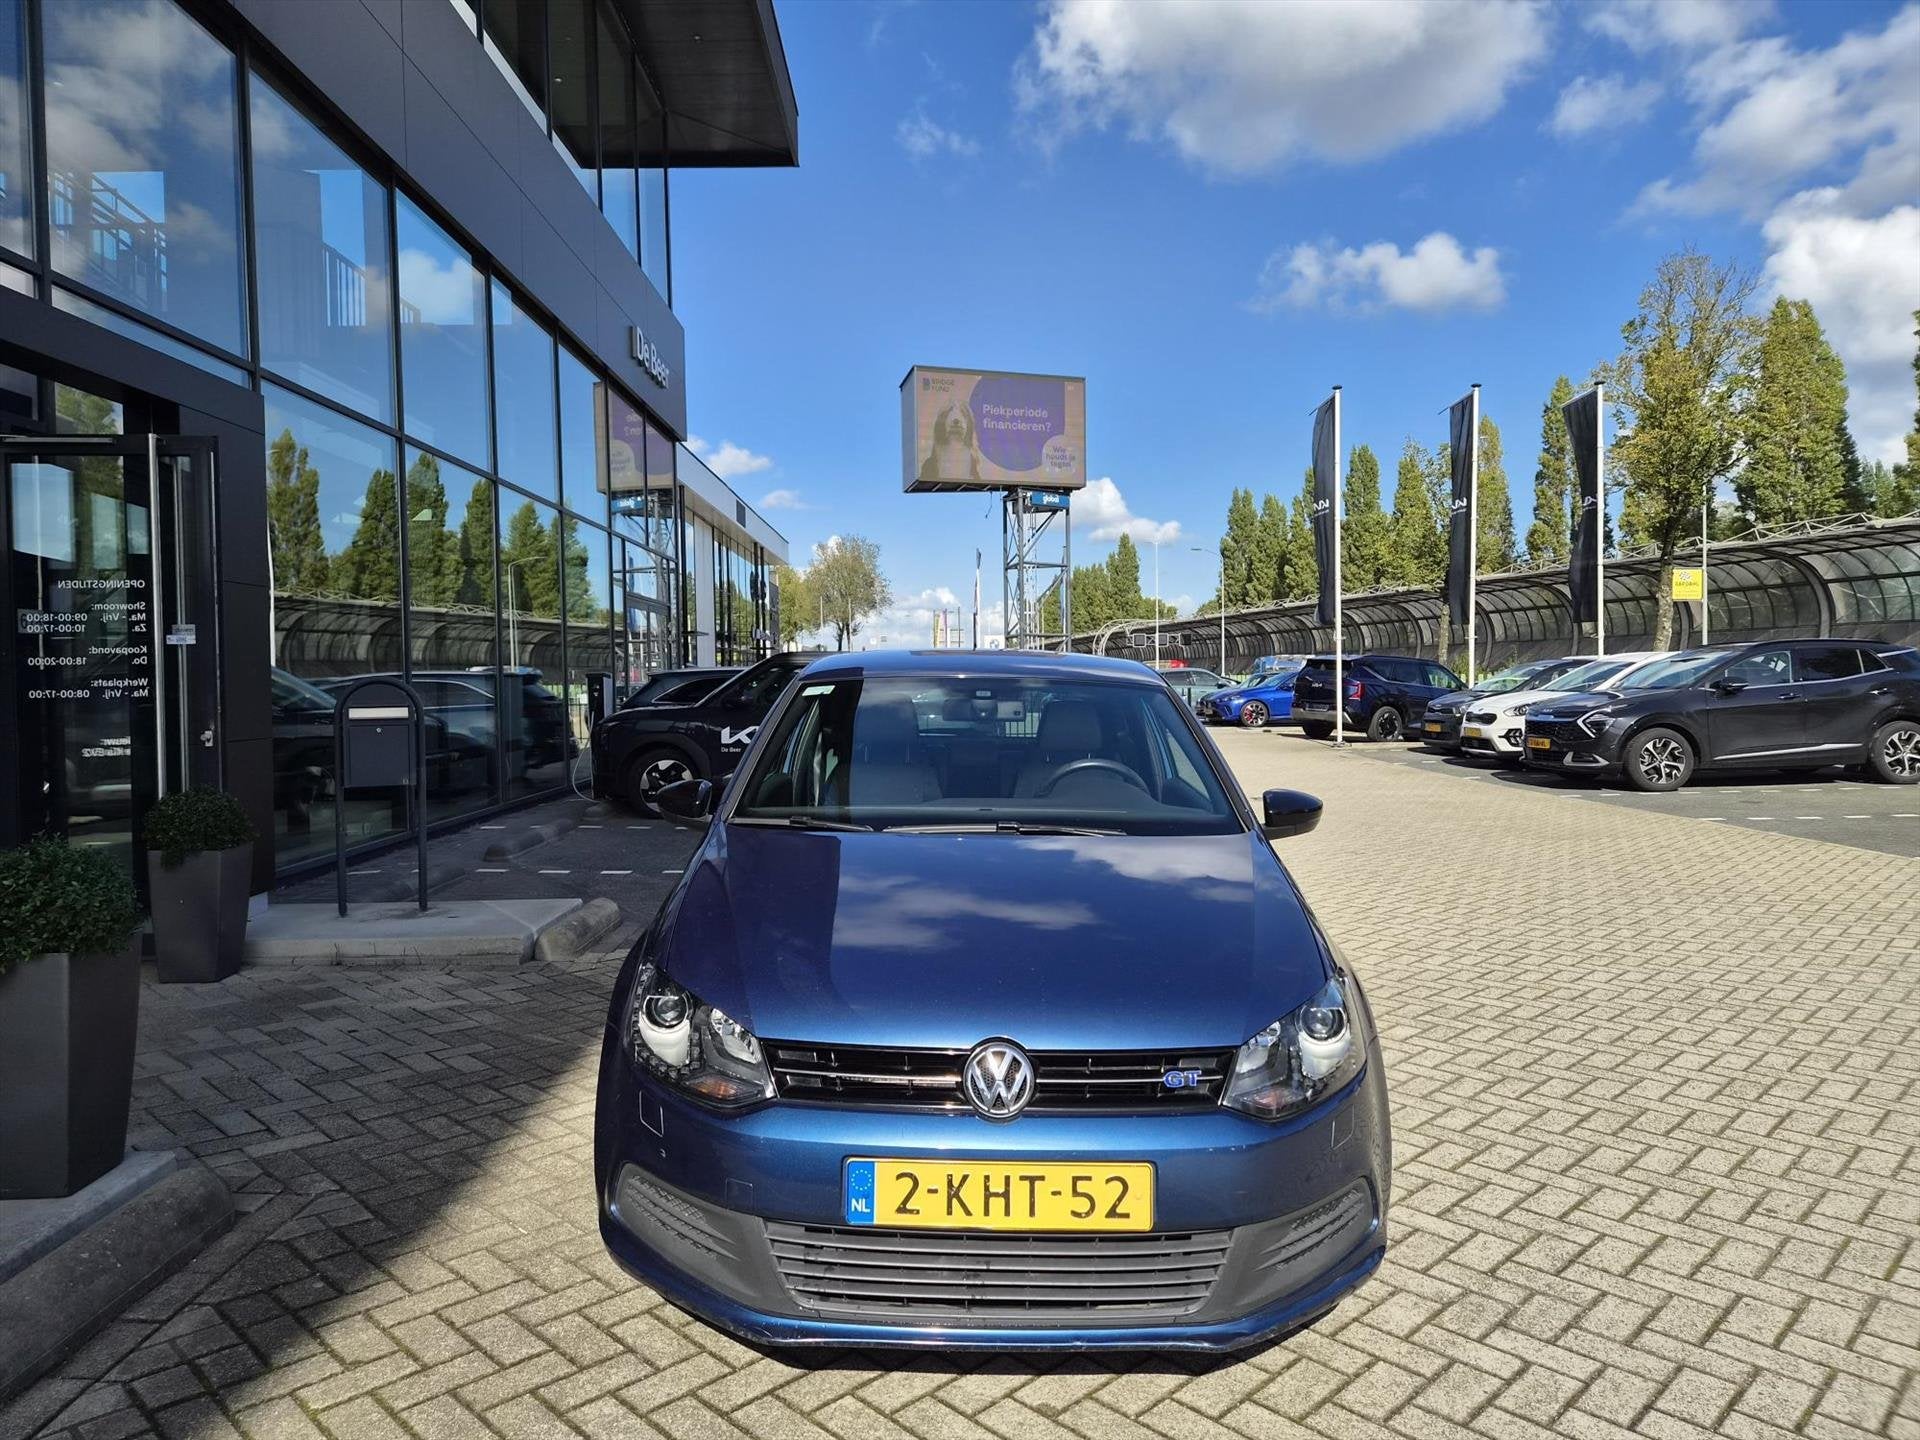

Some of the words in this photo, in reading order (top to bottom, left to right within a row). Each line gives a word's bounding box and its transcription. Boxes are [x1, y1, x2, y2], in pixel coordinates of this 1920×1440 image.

[982, 403, 1049, 419] Piekperiode
[982, 418, 1052, 433] financieren?
[1162, 1069, 1202, 1089] GT
[894, 1171, 1132, 1220] 2-KHT-52
[851, 1197, 871, 1214] NL
